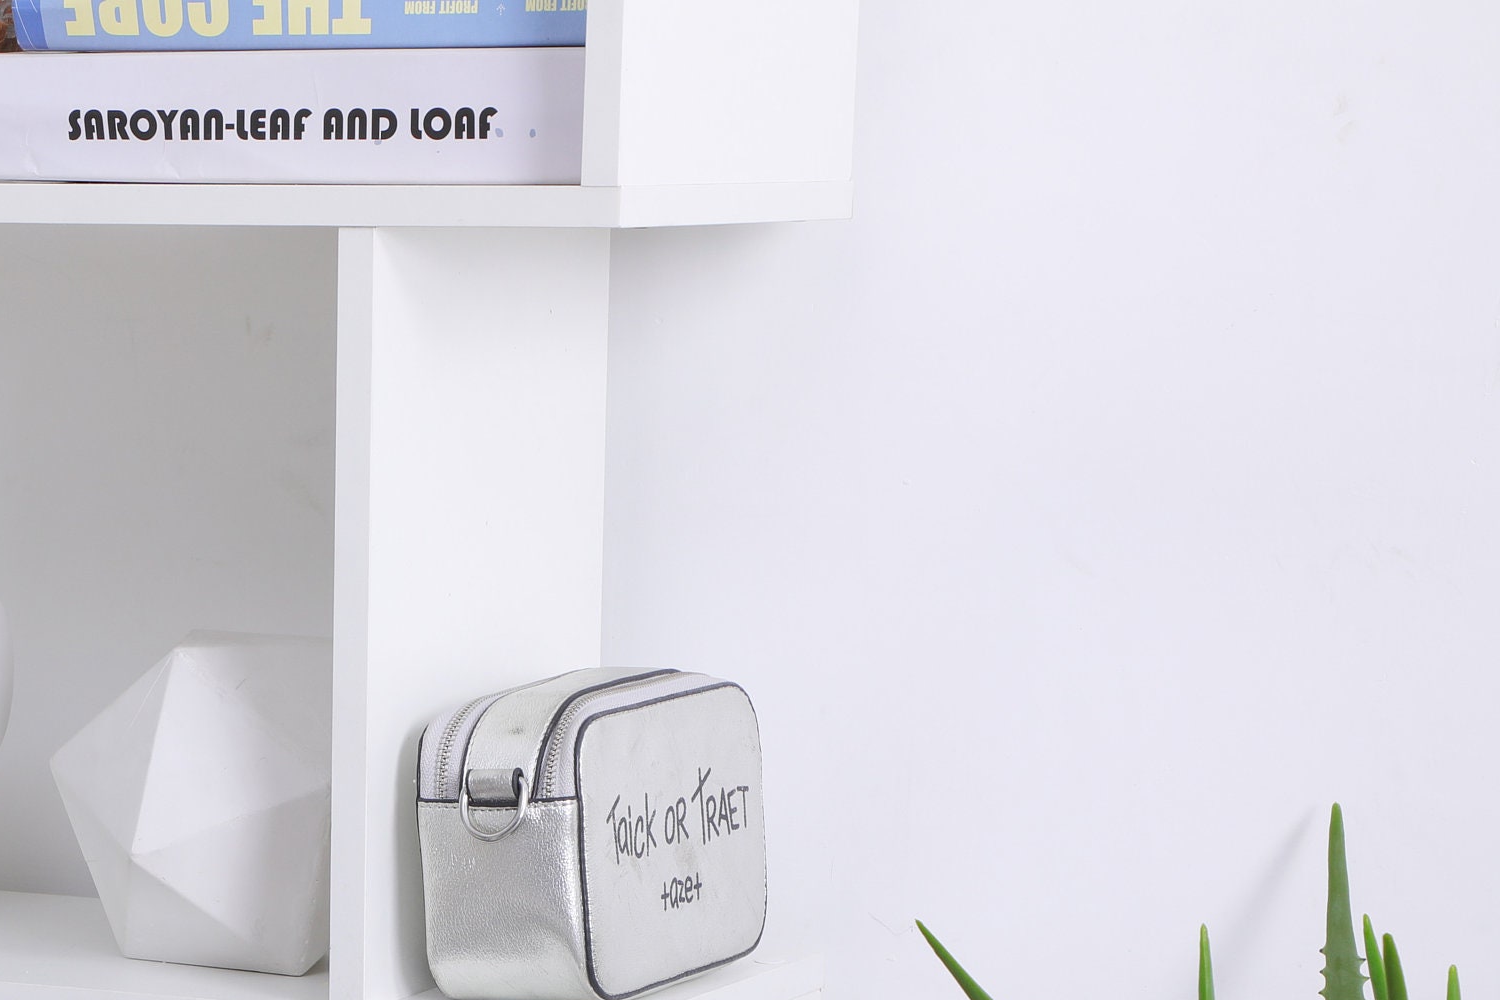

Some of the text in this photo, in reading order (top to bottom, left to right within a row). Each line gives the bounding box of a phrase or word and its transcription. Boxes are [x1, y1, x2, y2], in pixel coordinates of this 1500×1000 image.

[252, 0, 371, 36] THE
[403, 0, 436, 15] FROM
[559, 0, 587, 12] OFIT
[68, 106, 498, 142] SAROYAN-LEAF AND LOAF
[664, 797, 690, 845] OR
[691, 767, 750, 846] TRAET
